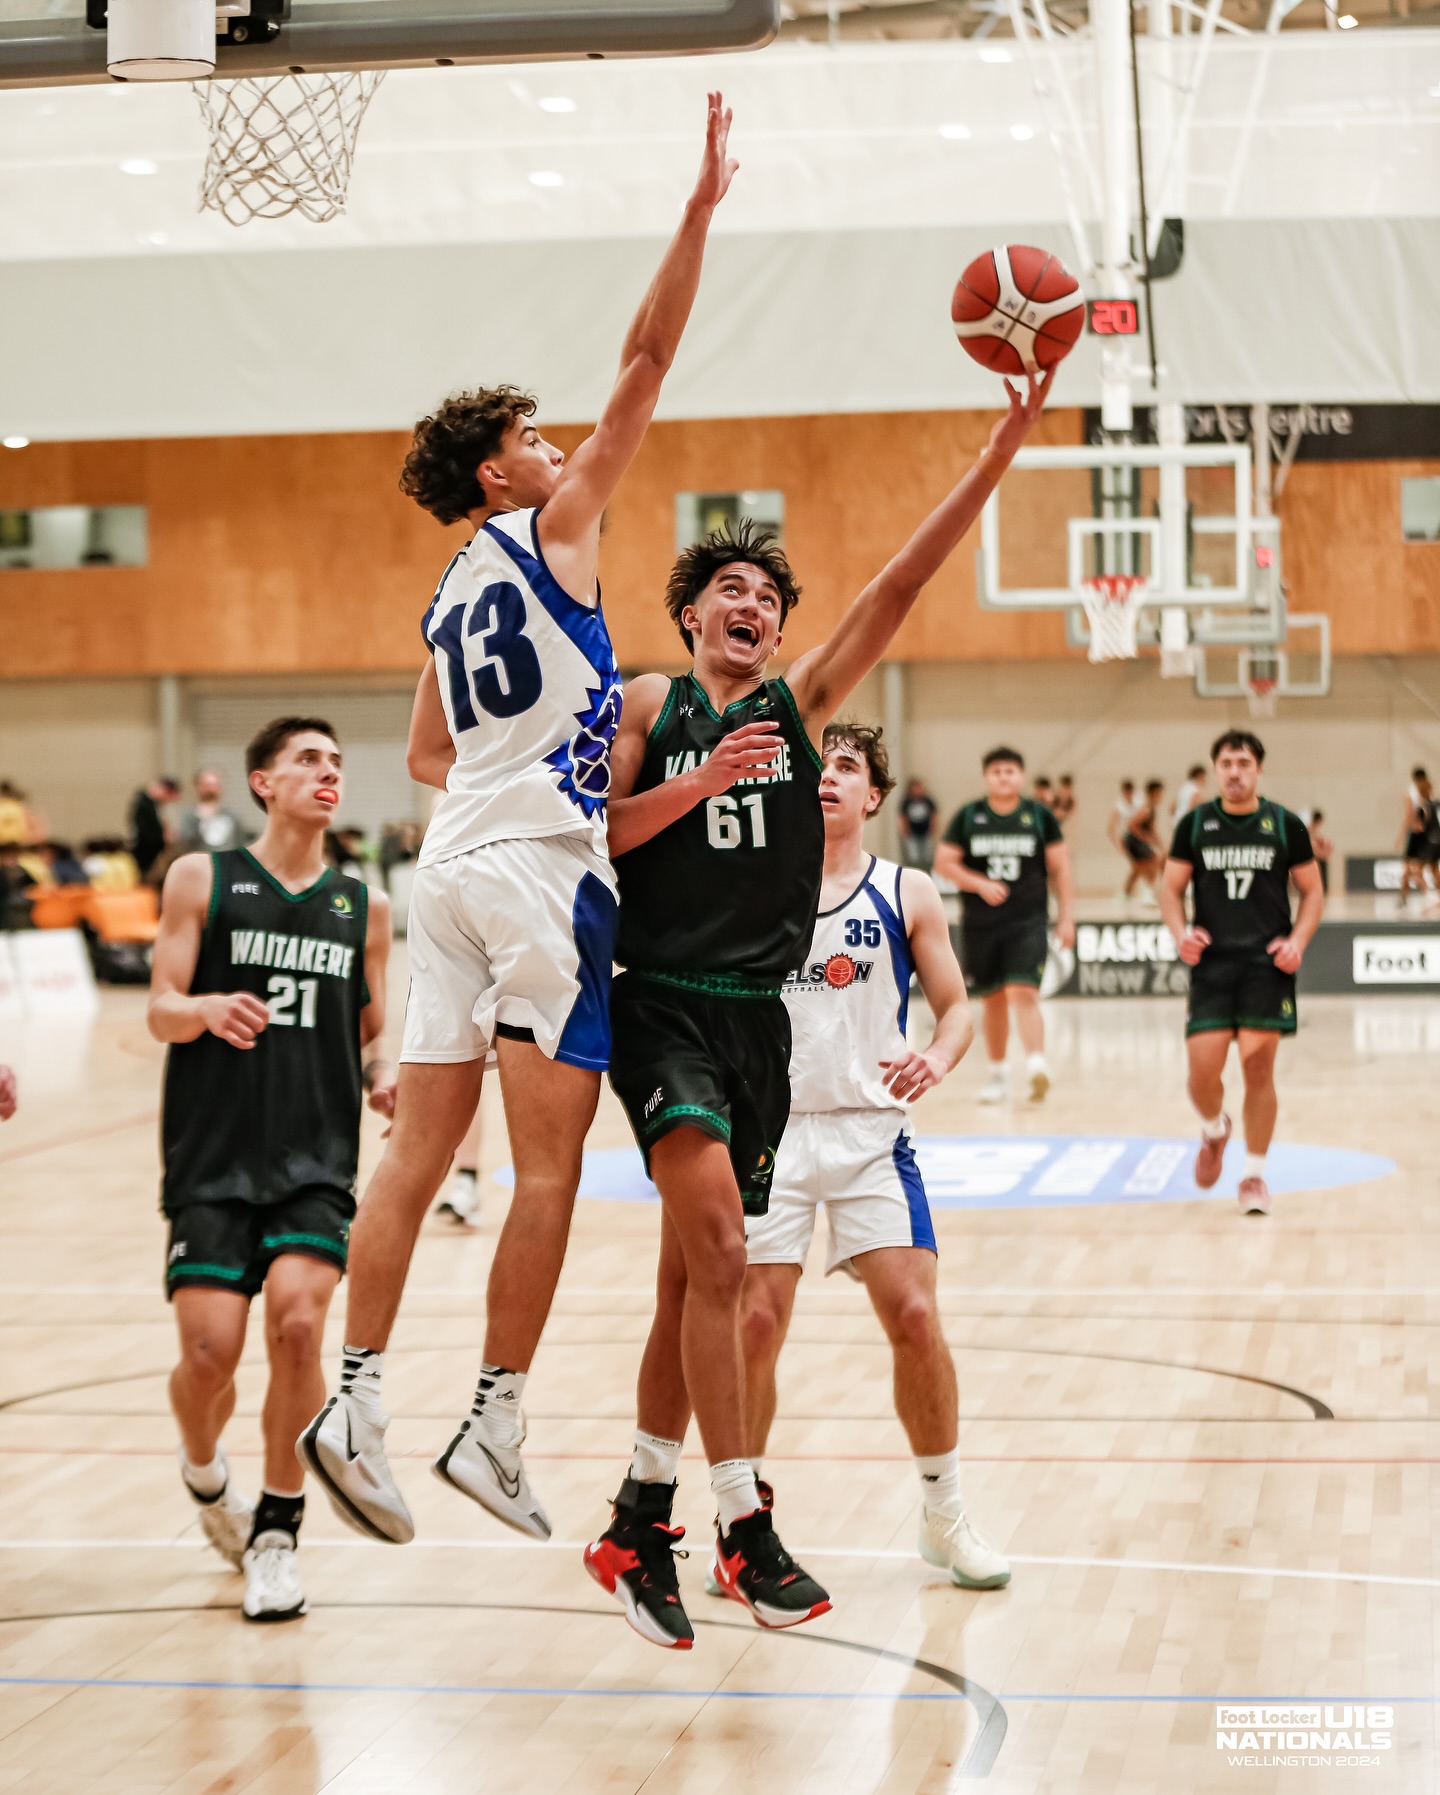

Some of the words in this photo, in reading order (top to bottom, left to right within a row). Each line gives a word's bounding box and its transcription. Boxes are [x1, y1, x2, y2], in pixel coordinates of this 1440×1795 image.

[1091, 300, 1137, 334] 20
[1250, 407, 1352, 434] entre
[430, 580, 542, 734] 13
[706, 793, 766, 849] 61
[1224, 870, 1255, 900] 17
[844, 918, 881, 949] 35
[230, 930, 354, 980] WAITAKERE
[1365, 950, 1427, 972] Foot
[1079, 962, 1145, 994] New
[265, 973, 319, 1029] 21
[644, 1087, 663, 1119] PURE
